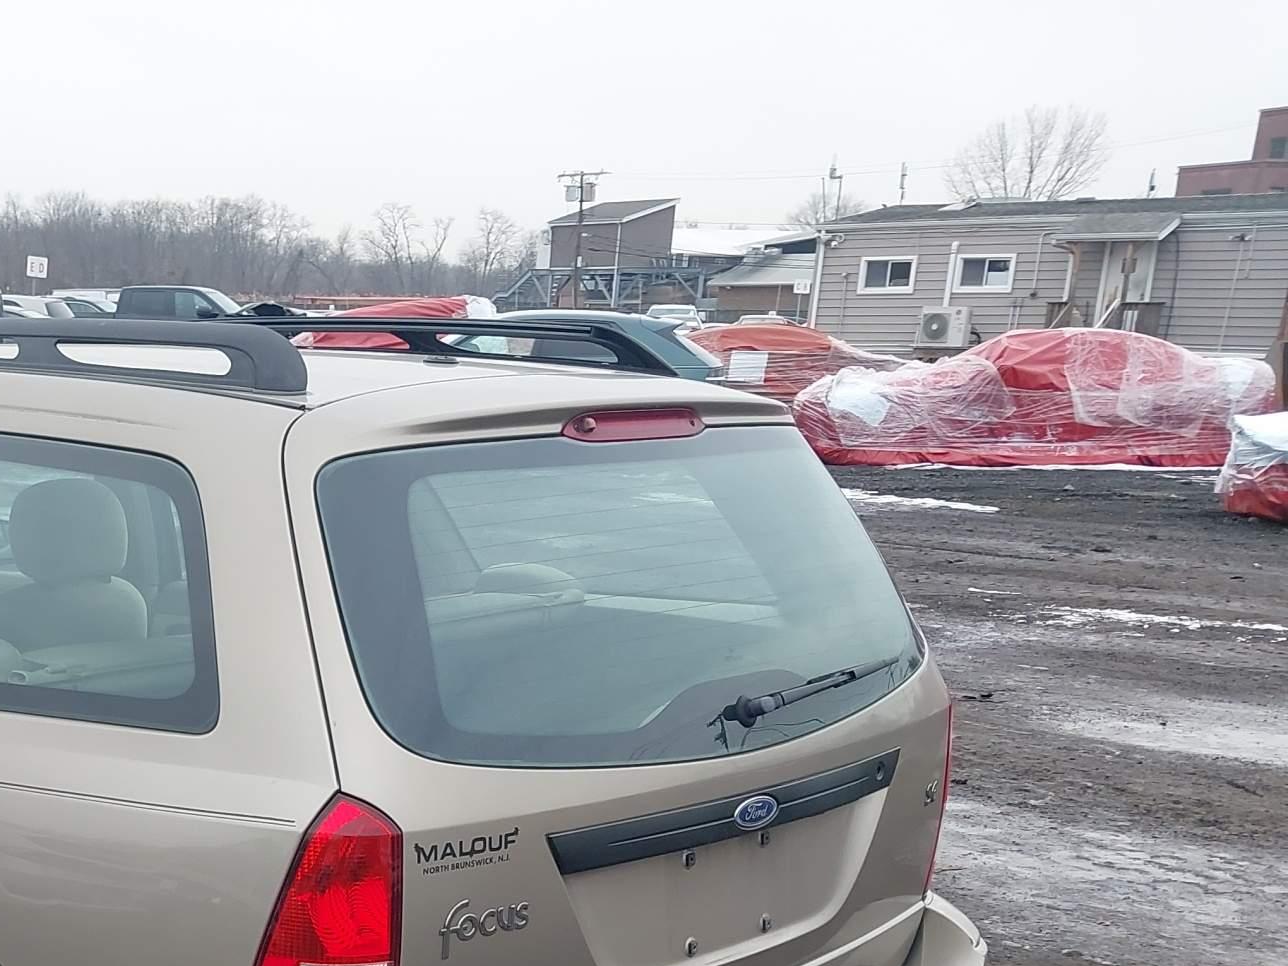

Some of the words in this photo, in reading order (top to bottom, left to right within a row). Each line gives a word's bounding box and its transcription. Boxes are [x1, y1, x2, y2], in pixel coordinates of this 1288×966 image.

[745, 802, 769, 821] Ford
[413, 827, 519, 864] MALOUF
[423, 864, 450, 876] NORTH
